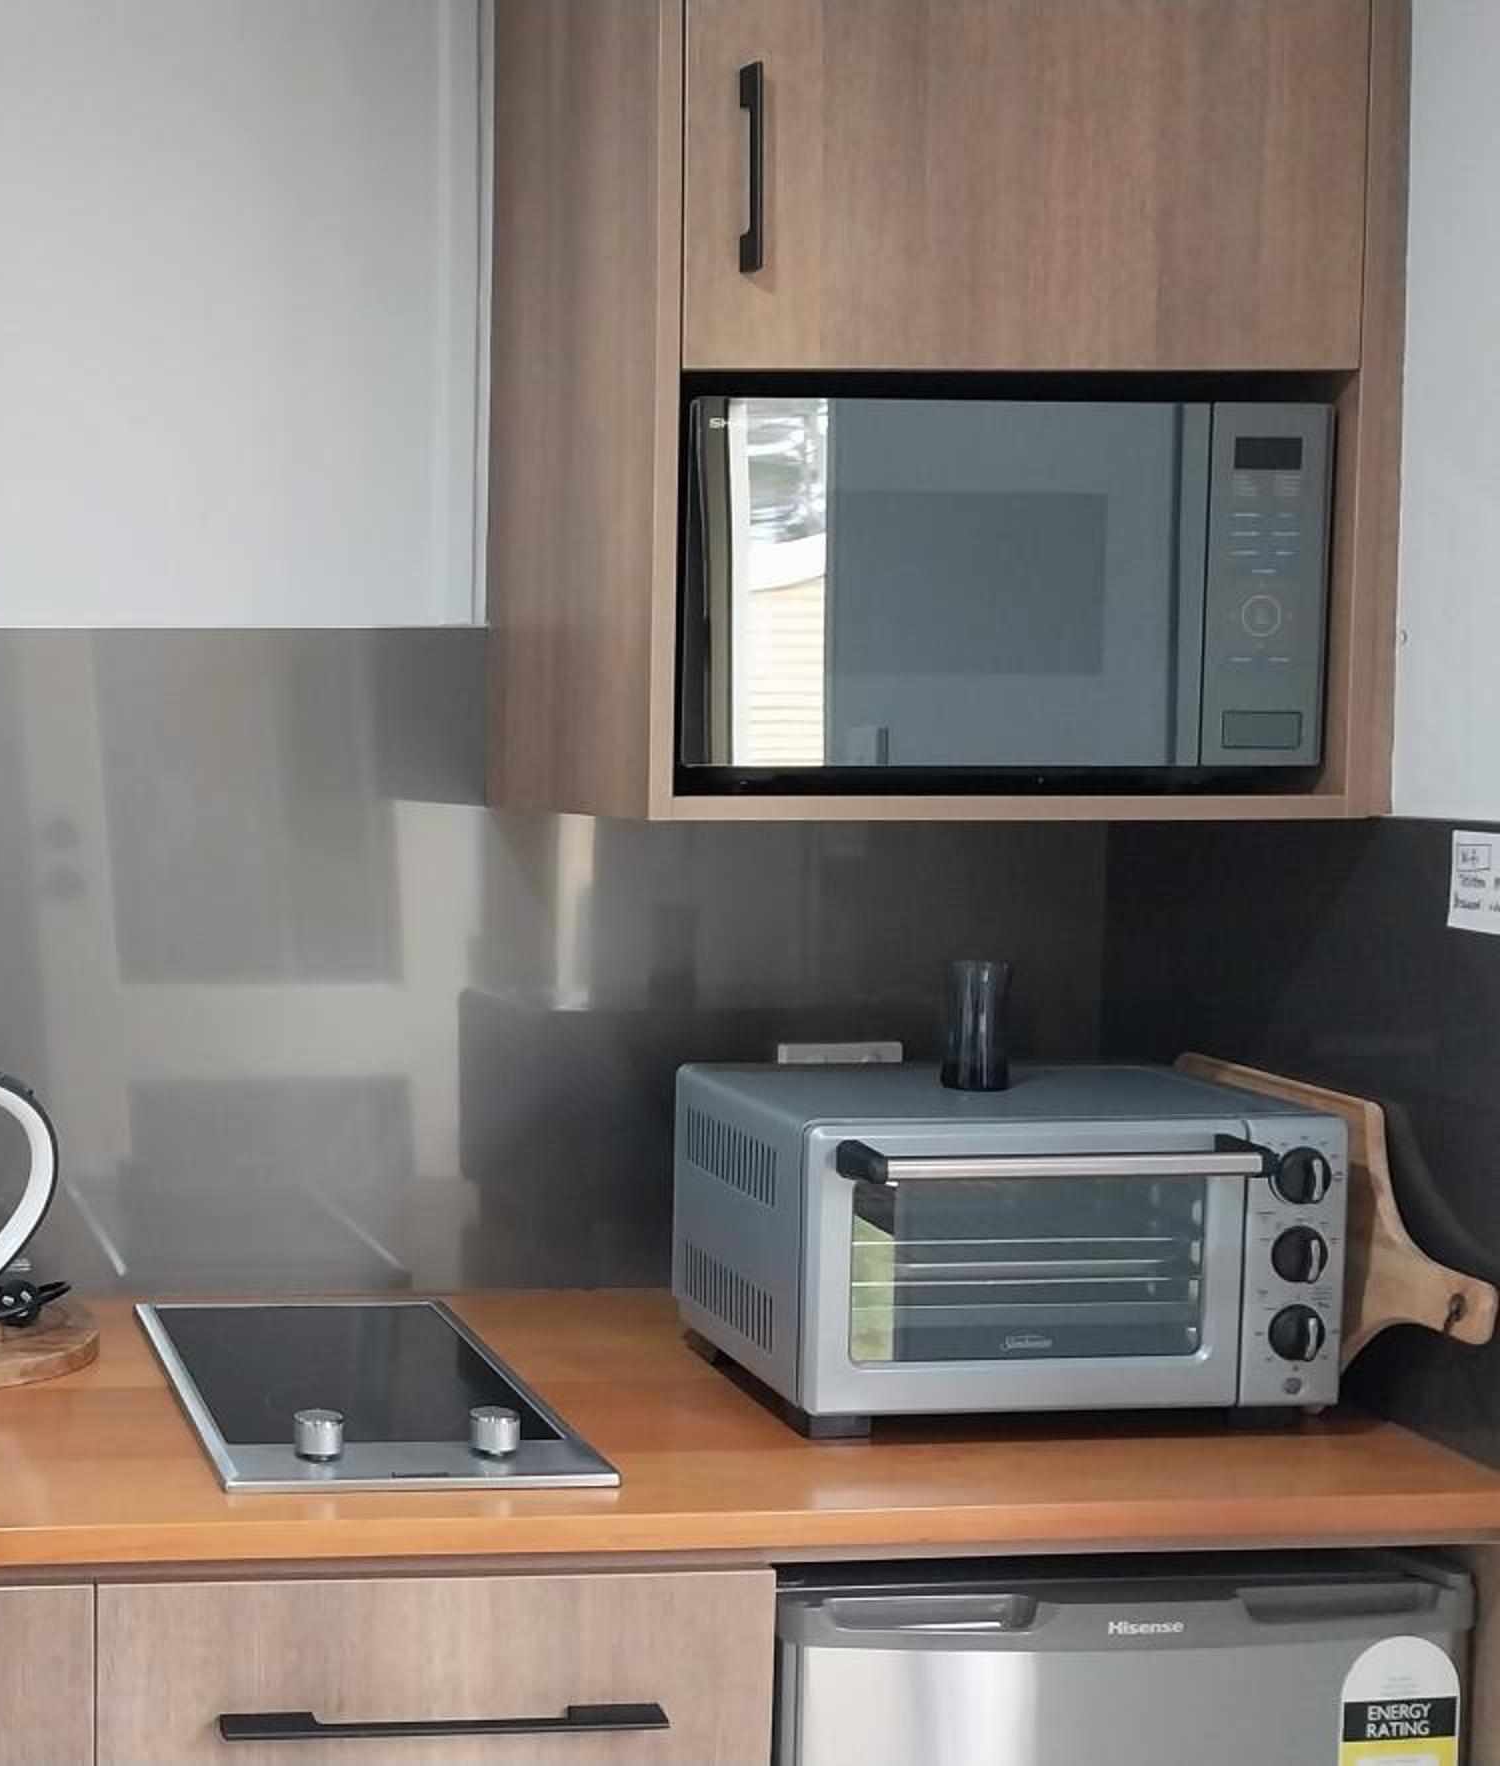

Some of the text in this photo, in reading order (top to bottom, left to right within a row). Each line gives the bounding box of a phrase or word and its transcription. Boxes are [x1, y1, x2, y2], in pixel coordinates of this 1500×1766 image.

[1108, 1621, 1184, 1635] Hisense
[1367, 1703, 1431, 1721] ENERGY
[1366, 1721, 1430, 1738] RATING
